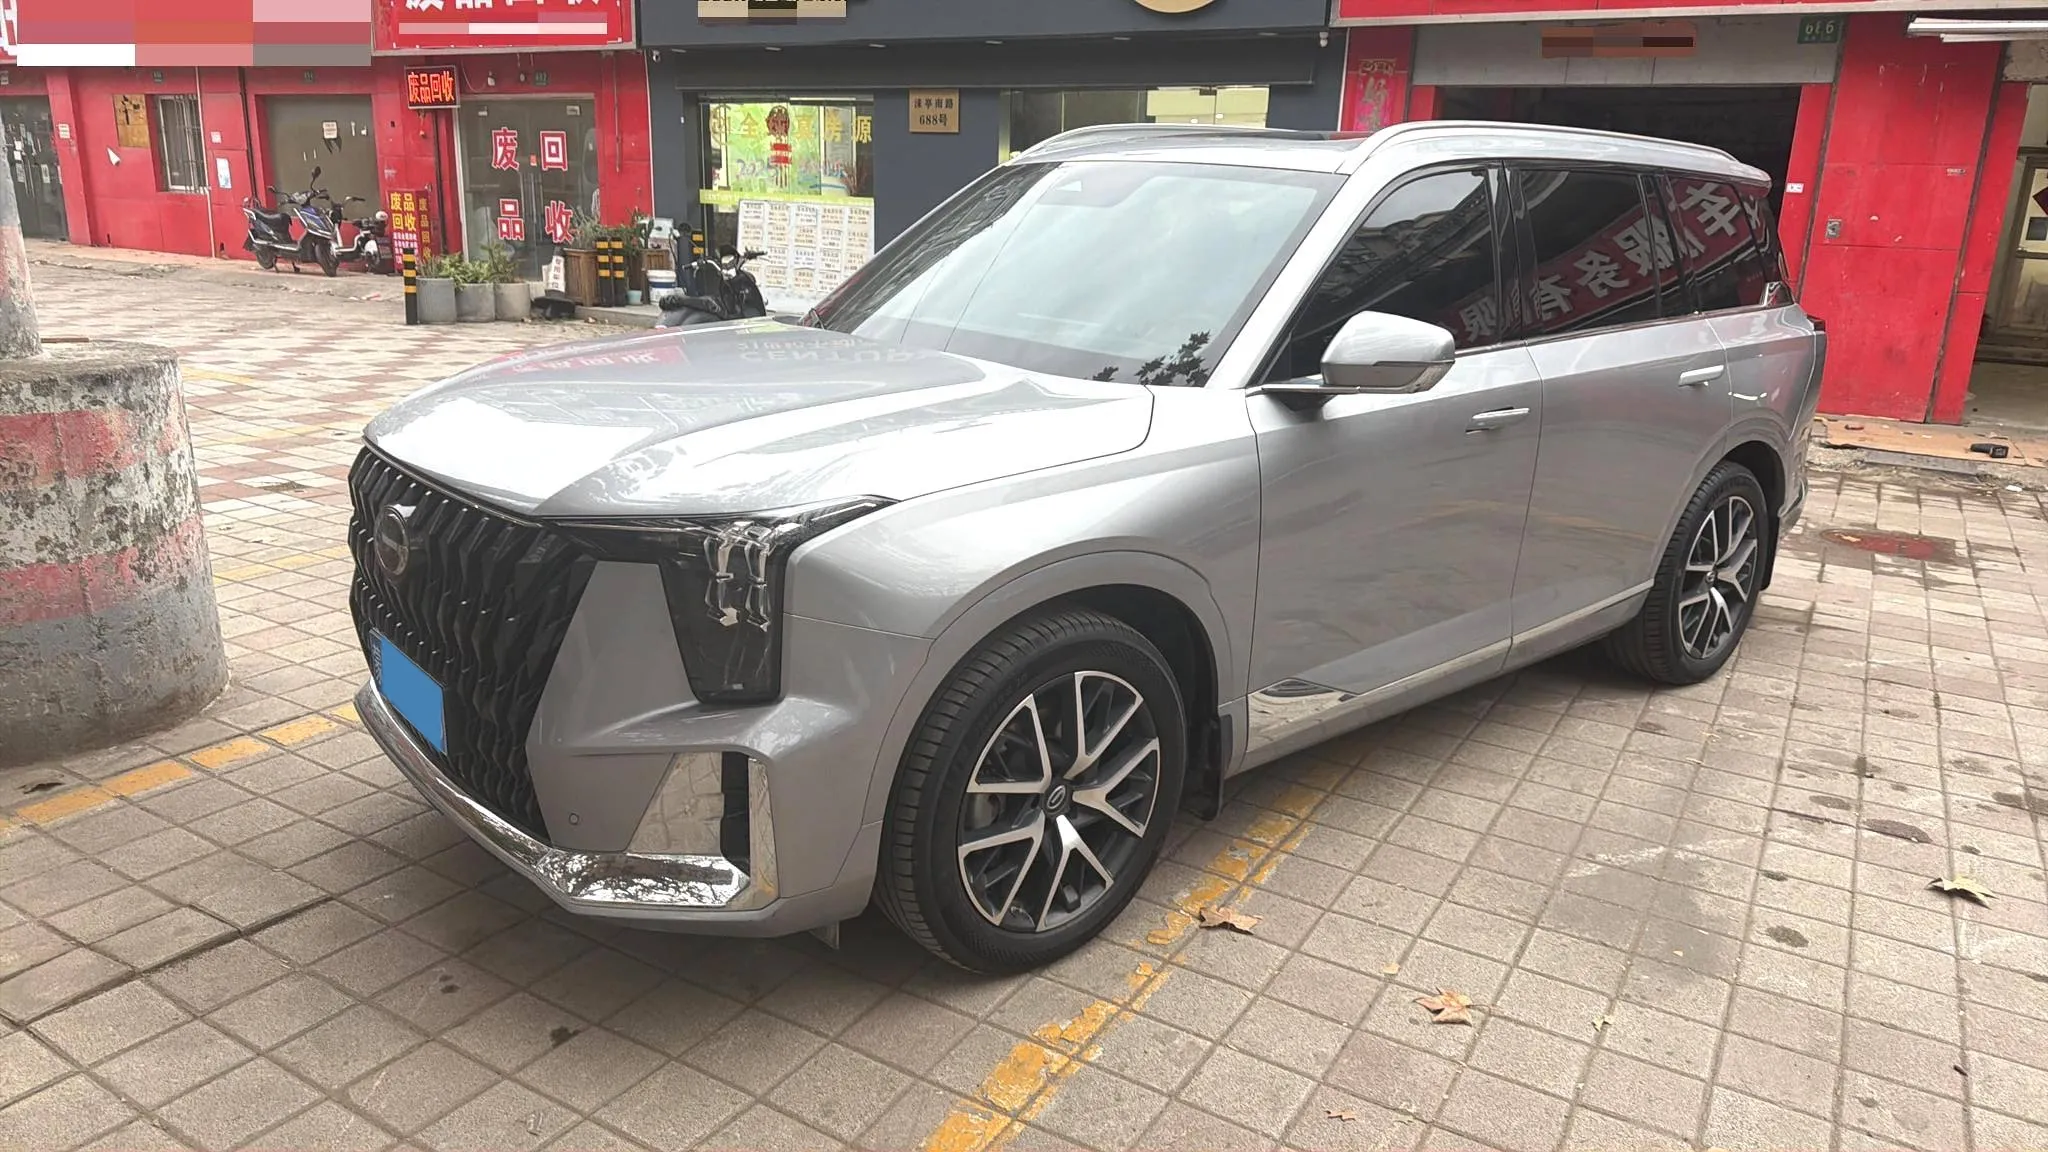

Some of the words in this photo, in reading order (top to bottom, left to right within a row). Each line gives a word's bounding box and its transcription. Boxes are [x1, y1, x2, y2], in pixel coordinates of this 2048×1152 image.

[408, 71, 454, 104] 废品回收
[919, 113, 947, 127] 688号
[390, 192, 415, 212] 废品
[392, 212, 417, 232] 回收
